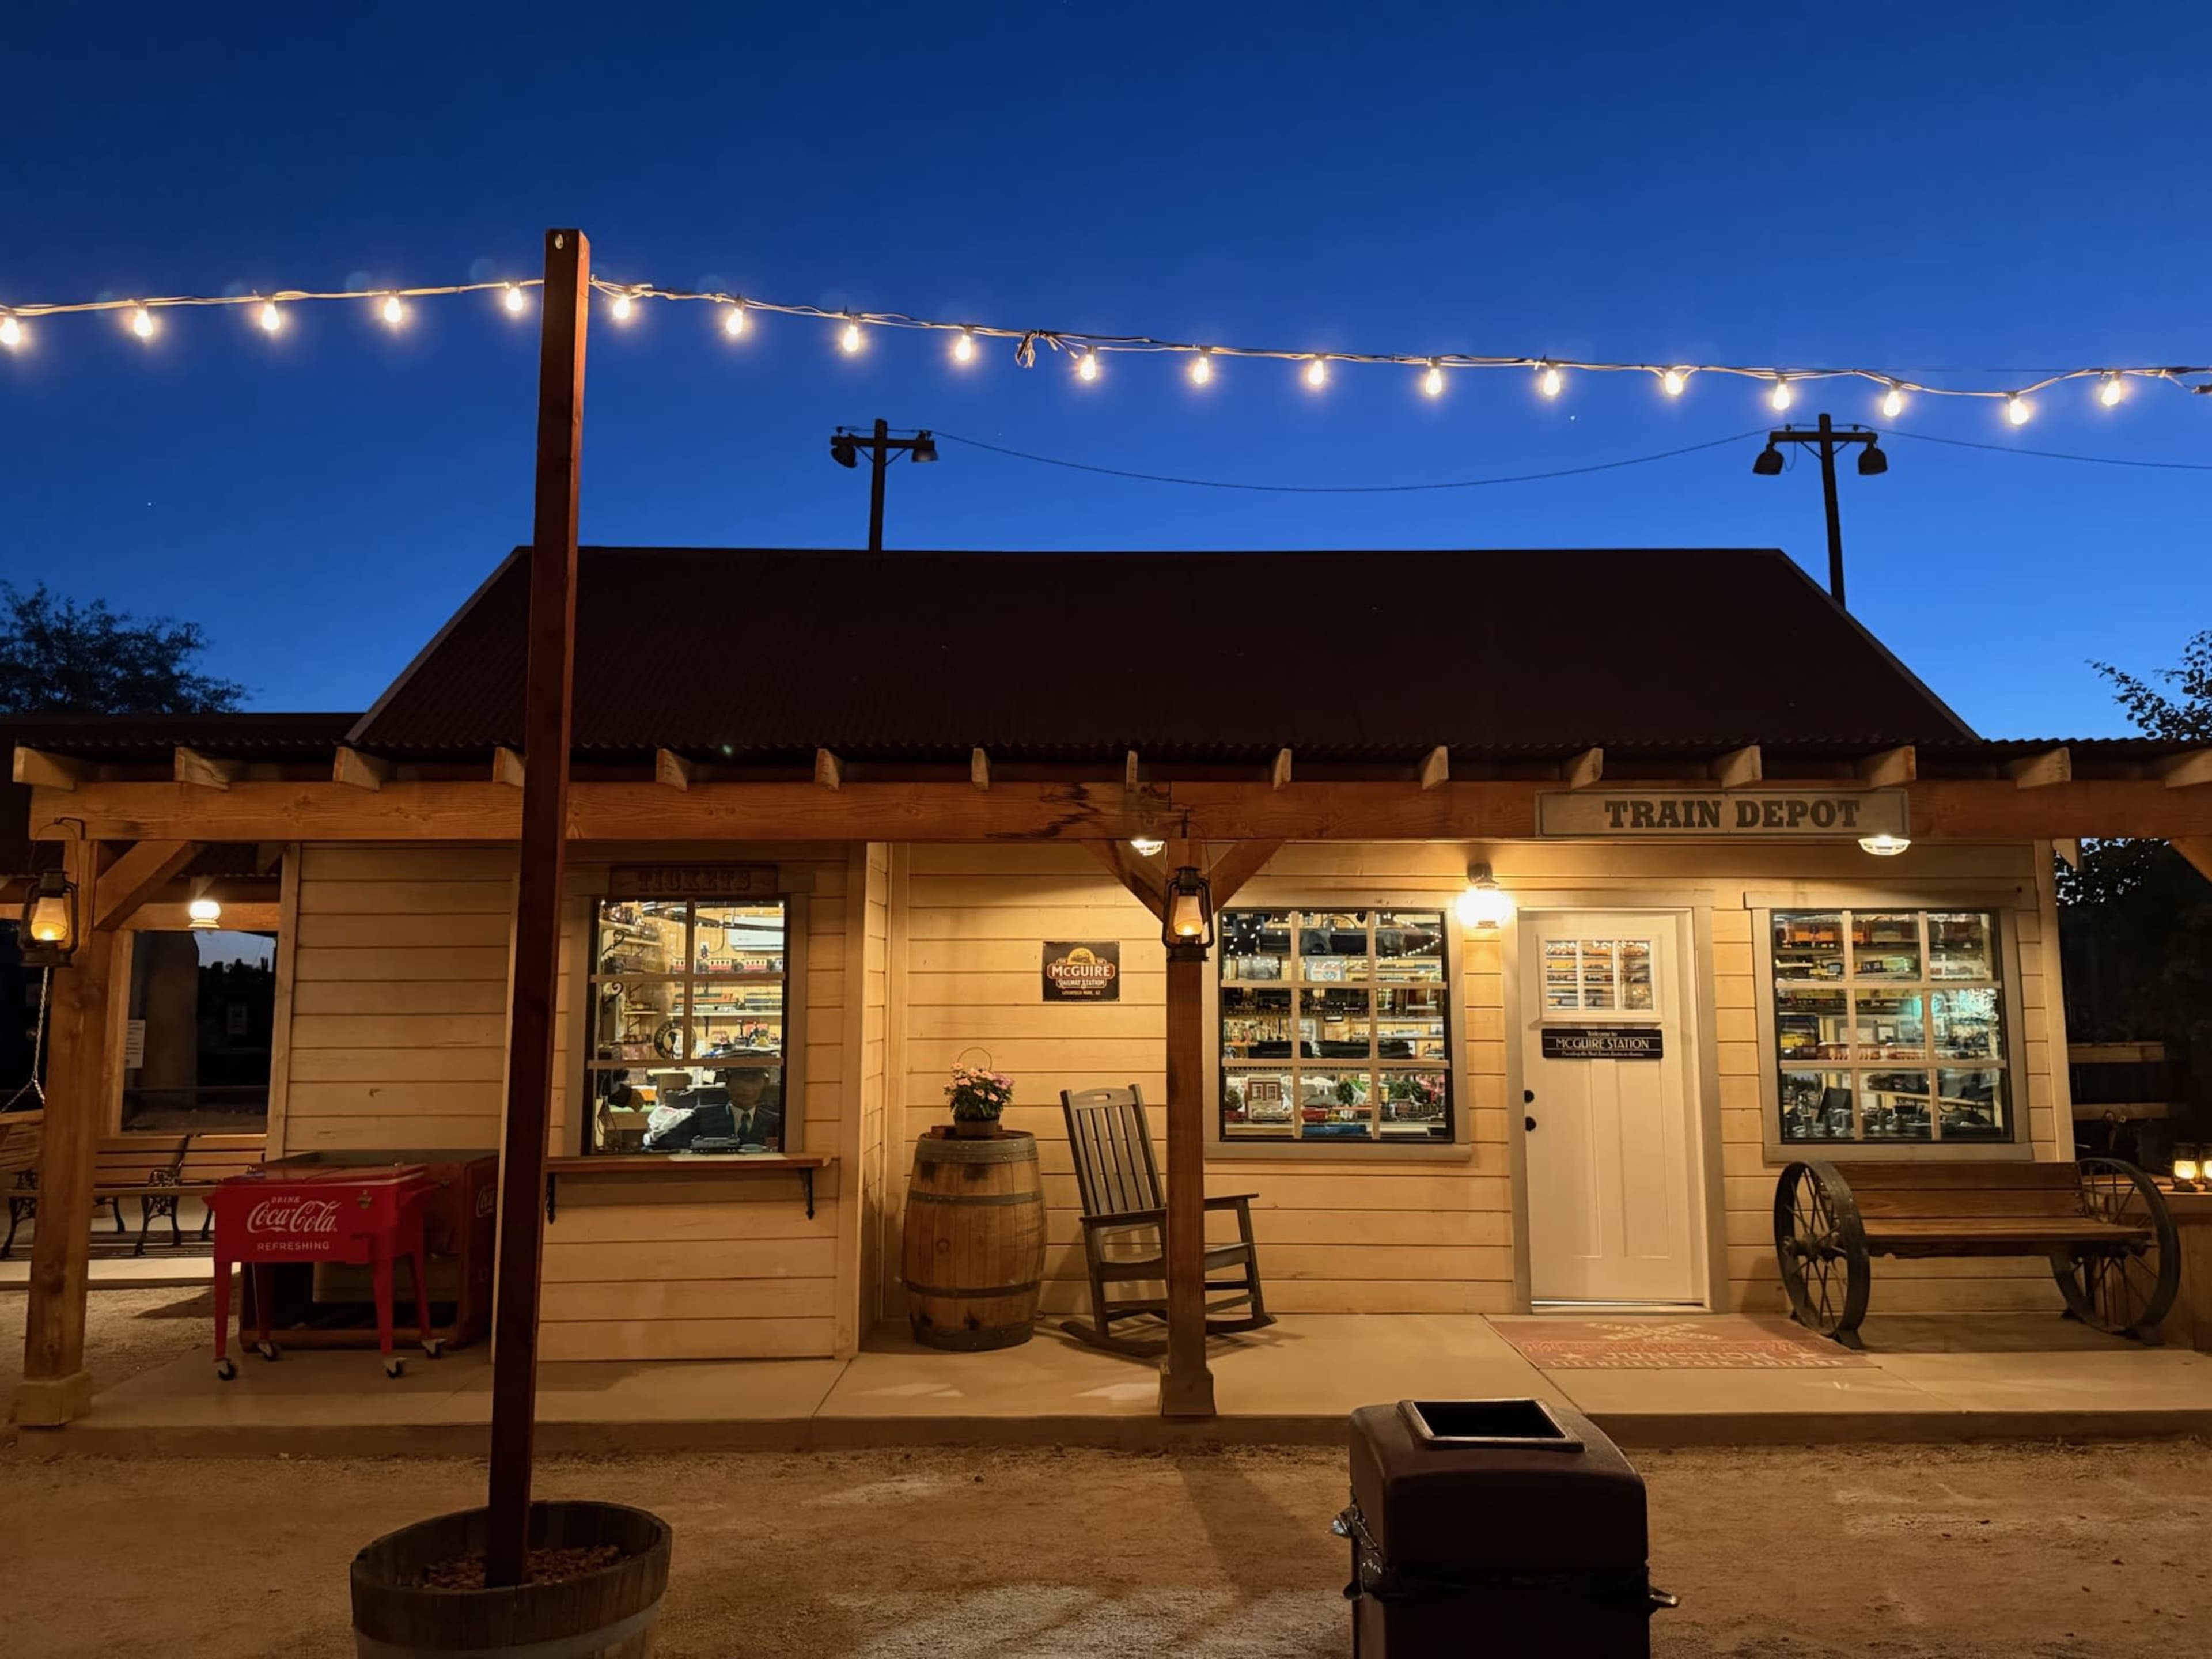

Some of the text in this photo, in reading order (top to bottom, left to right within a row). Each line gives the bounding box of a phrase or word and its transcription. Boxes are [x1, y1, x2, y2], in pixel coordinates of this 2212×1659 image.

[1604, 800, 1861, 828] TRAIN DEPOT
[638, 870, 751, 891] TICKETS
[1052, 965, 1111, 977] McGUIRE
[1556, 1038, 1649, 1049] MCGUIRE STATION
[257, 1241, 330, 1251] REFRESHING
